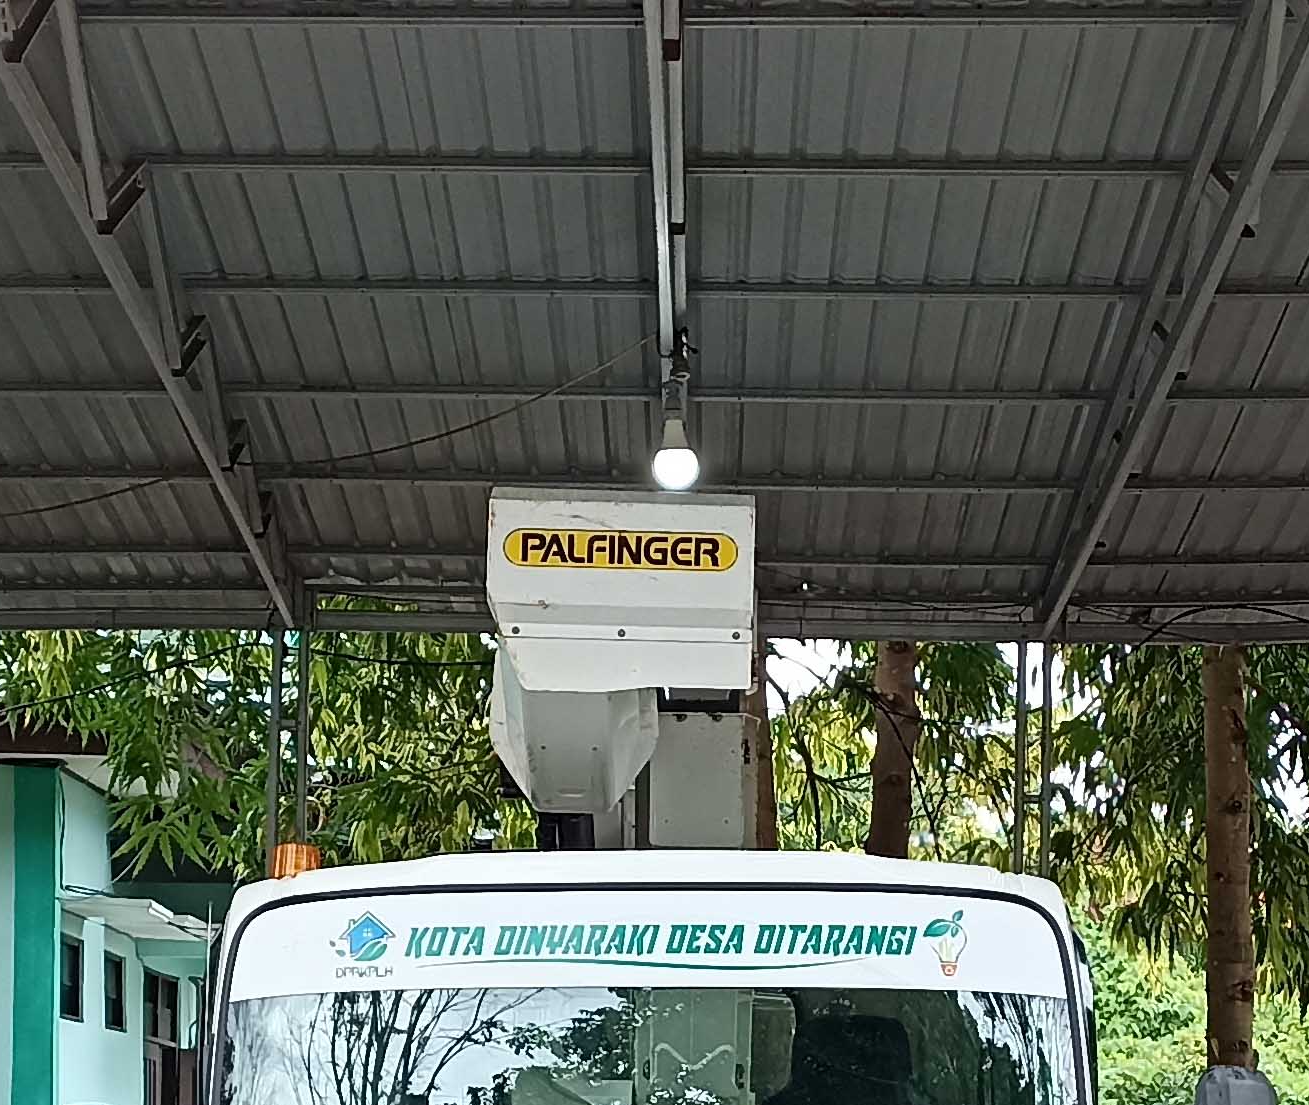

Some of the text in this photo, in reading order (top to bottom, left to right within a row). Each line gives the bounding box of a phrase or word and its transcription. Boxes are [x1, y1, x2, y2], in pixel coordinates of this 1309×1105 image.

[520, 532, 720, 567] PALFINGER
[404, 924, 918, 959] KOTA DINYARAKI DESA DITARANGI
